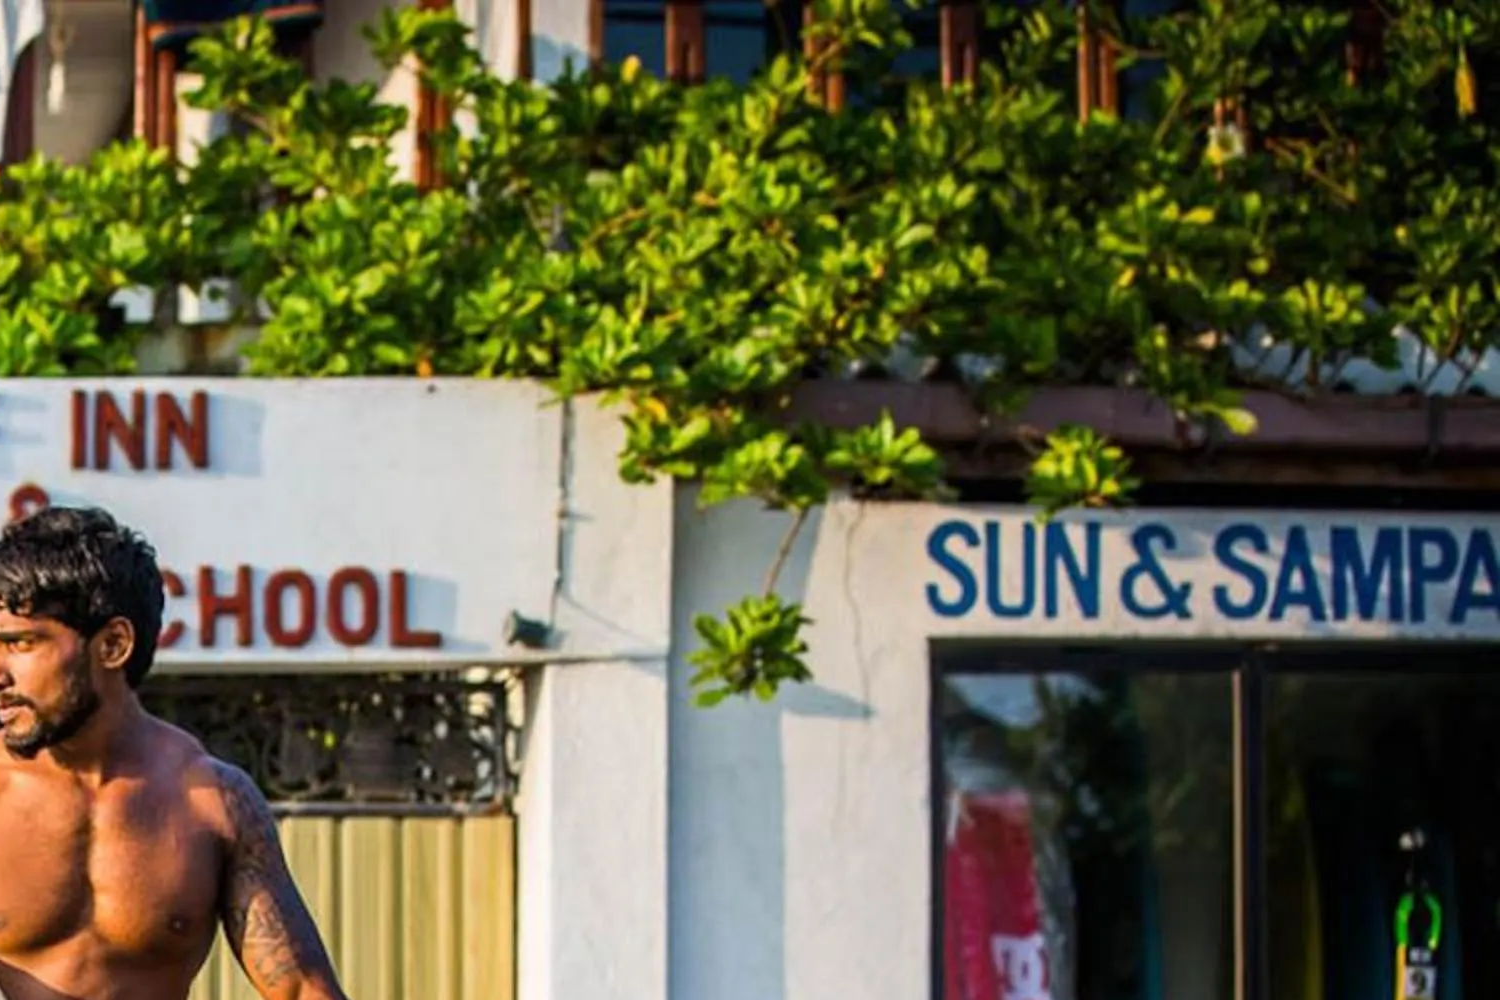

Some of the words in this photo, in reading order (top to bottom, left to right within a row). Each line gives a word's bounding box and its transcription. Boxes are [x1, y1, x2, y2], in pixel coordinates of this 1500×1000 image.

[71, 389, 210, 469] INN
[158, 566, 442, 649] HOOL
[926, 520, 1101, 619] SUN
[1120, 523, 1192, 619] &
[1212, 524, 1500, 623] SAMPA
